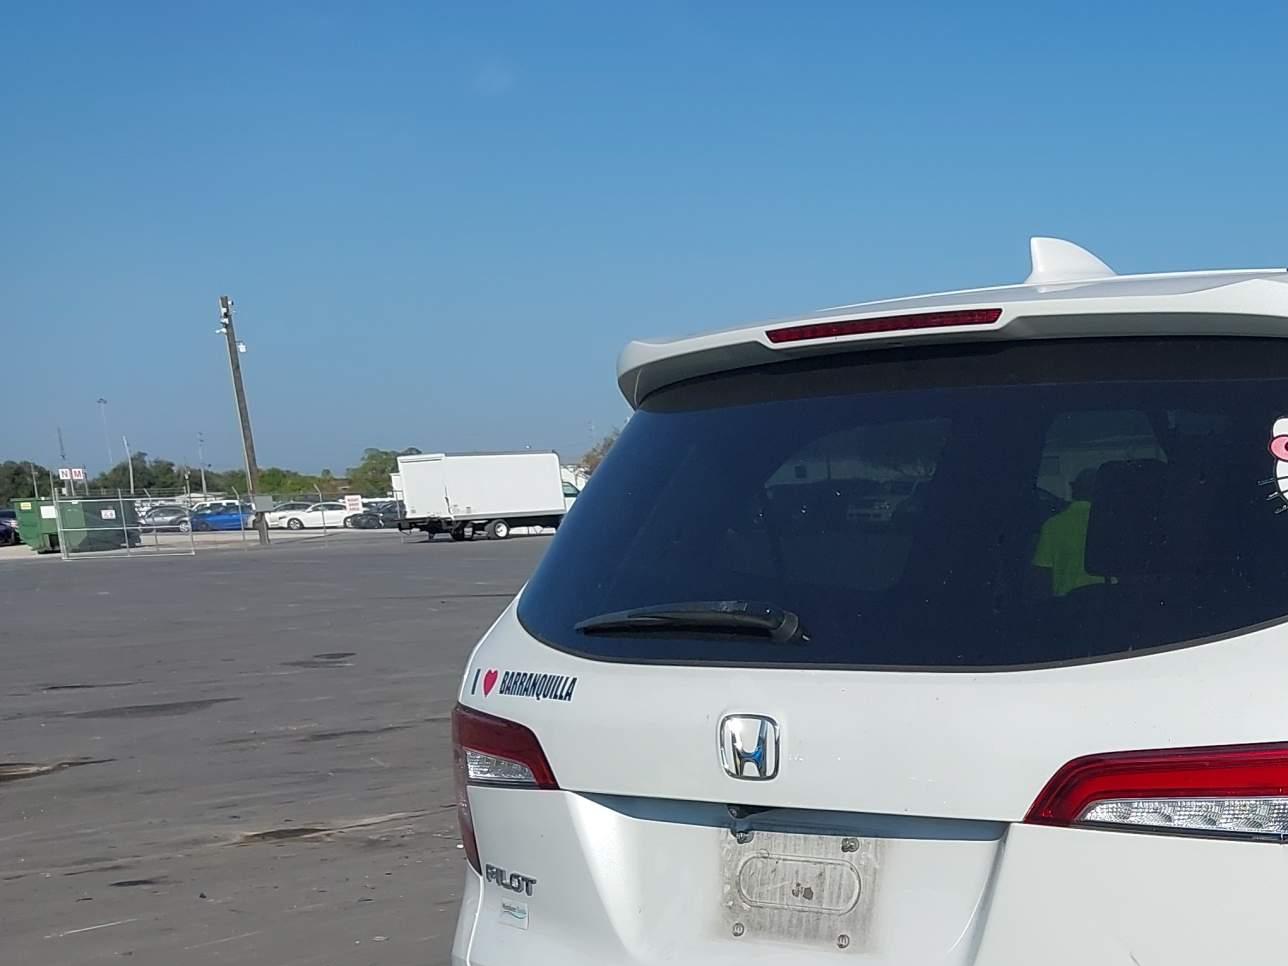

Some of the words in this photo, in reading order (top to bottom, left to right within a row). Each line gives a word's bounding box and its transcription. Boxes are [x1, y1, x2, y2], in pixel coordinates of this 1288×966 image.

[471, 668, 481, 696] I
[499, 671, 578, 701] BARRANQUILLA
[485, 863, 538, 897] PILOT
